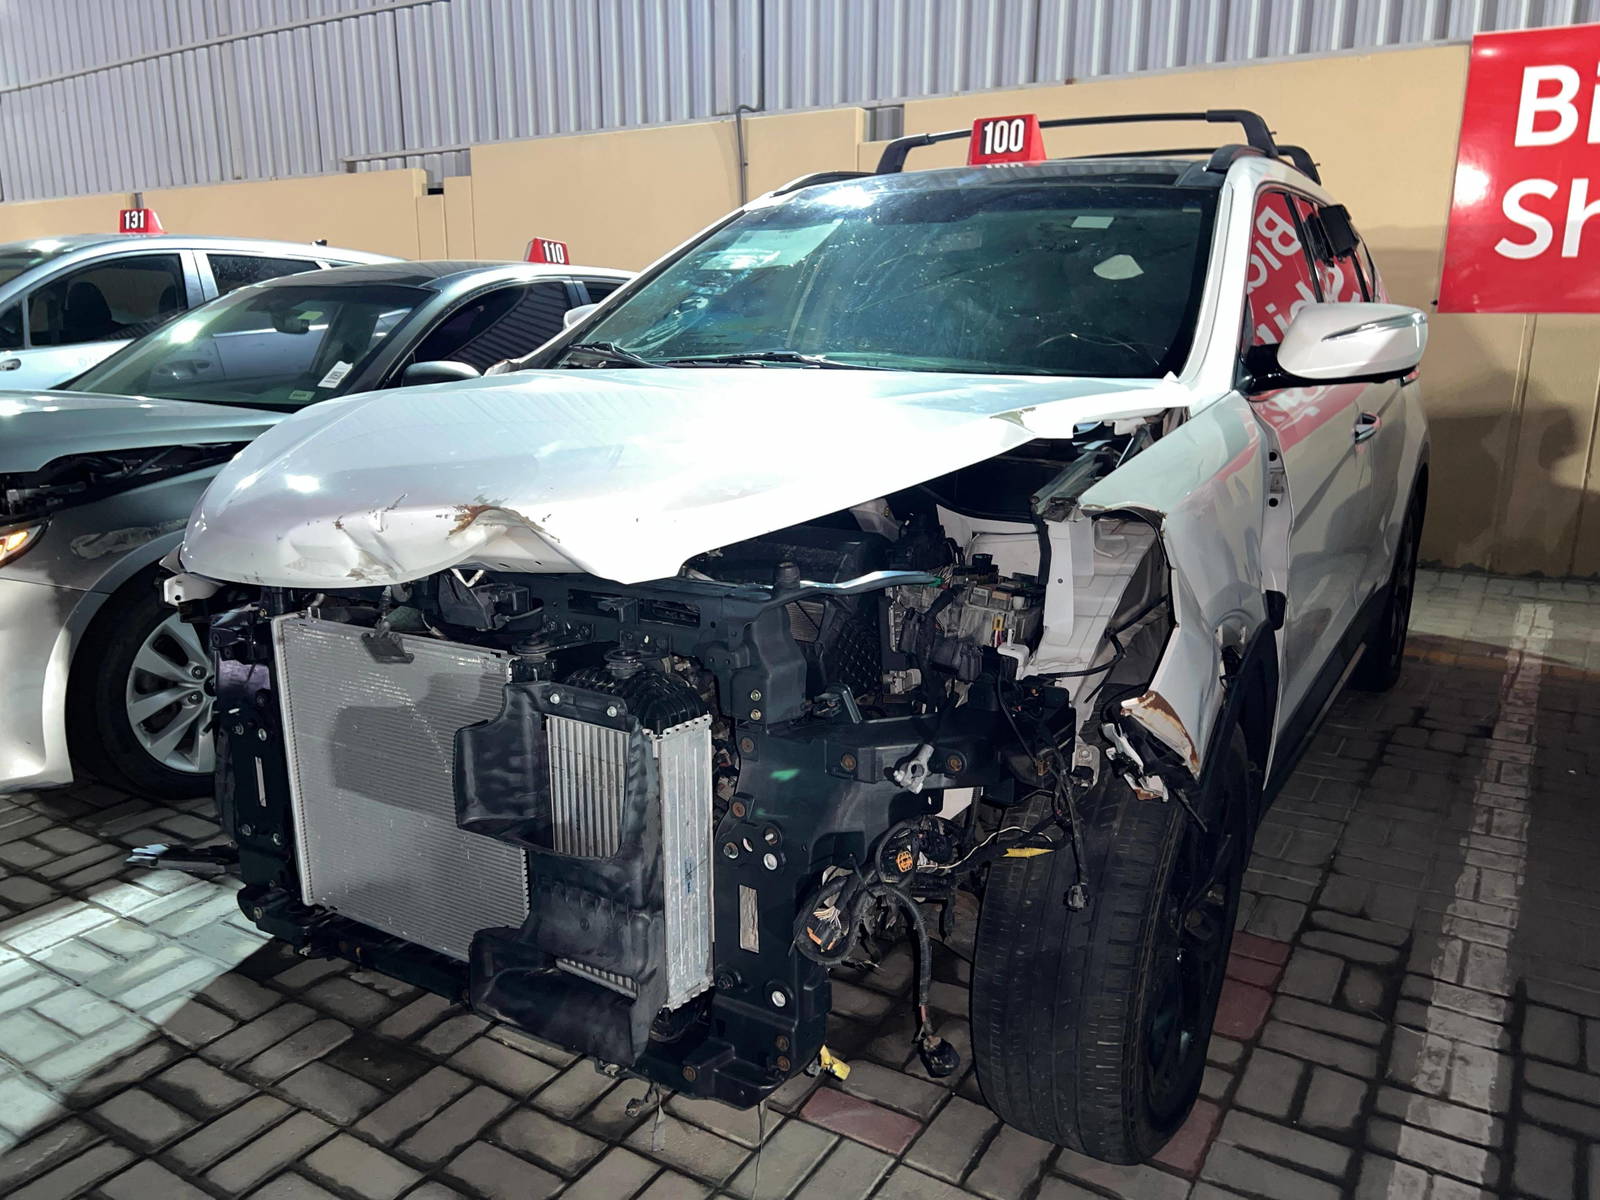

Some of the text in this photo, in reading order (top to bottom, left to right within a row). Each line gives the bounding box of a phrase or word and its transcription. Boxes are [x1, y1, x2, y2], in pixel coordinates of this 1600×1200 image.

[984, 119, 1024, 154] 100
[125, 210, 144, 230] 131
[543, 241, 565, 264] 110
